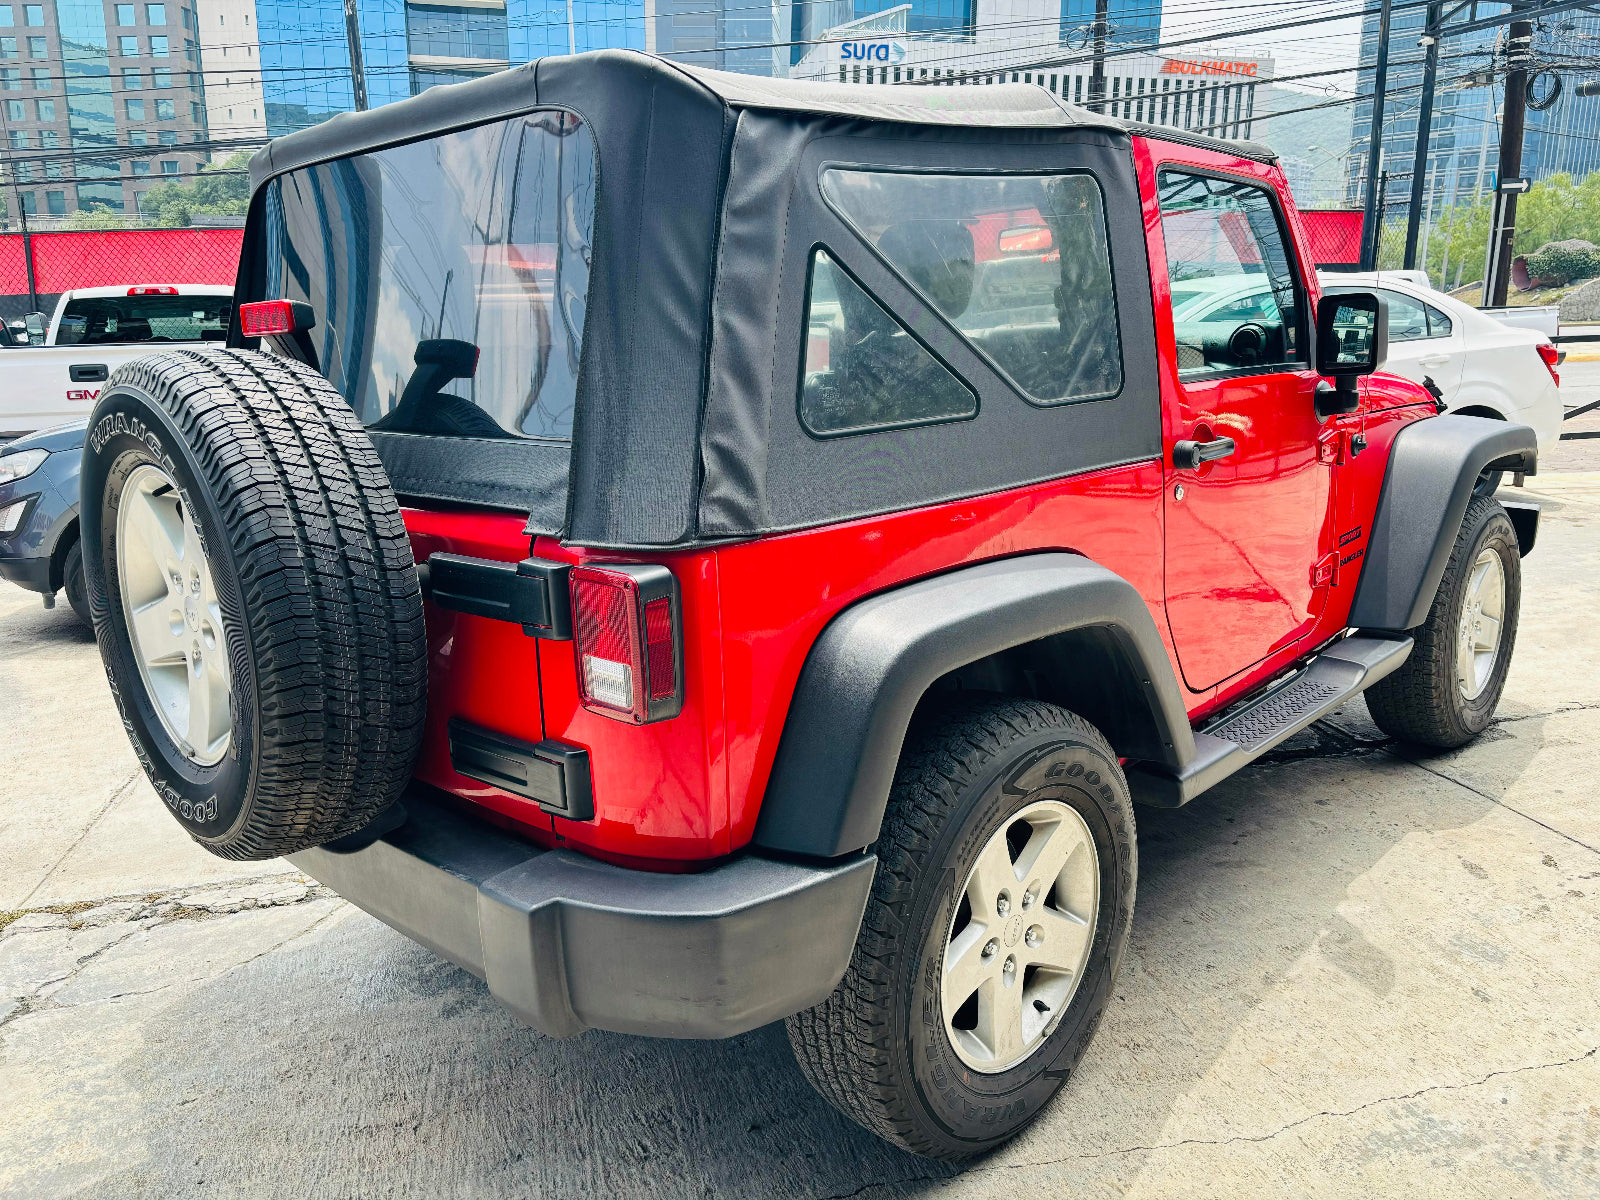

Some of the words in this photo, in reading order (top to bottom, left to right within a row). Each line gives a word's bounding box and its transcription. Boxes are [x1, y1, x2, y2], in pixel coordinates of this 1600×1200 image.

[841, 42, 889, 61] sura
[1169, 59, 1258, 76] BULKMATIC
[66, 389, 101, 400] GM
[1340, 548, 1364, 567] RANGLER
[1044, 761, 1132, 936] GOODYEAR
